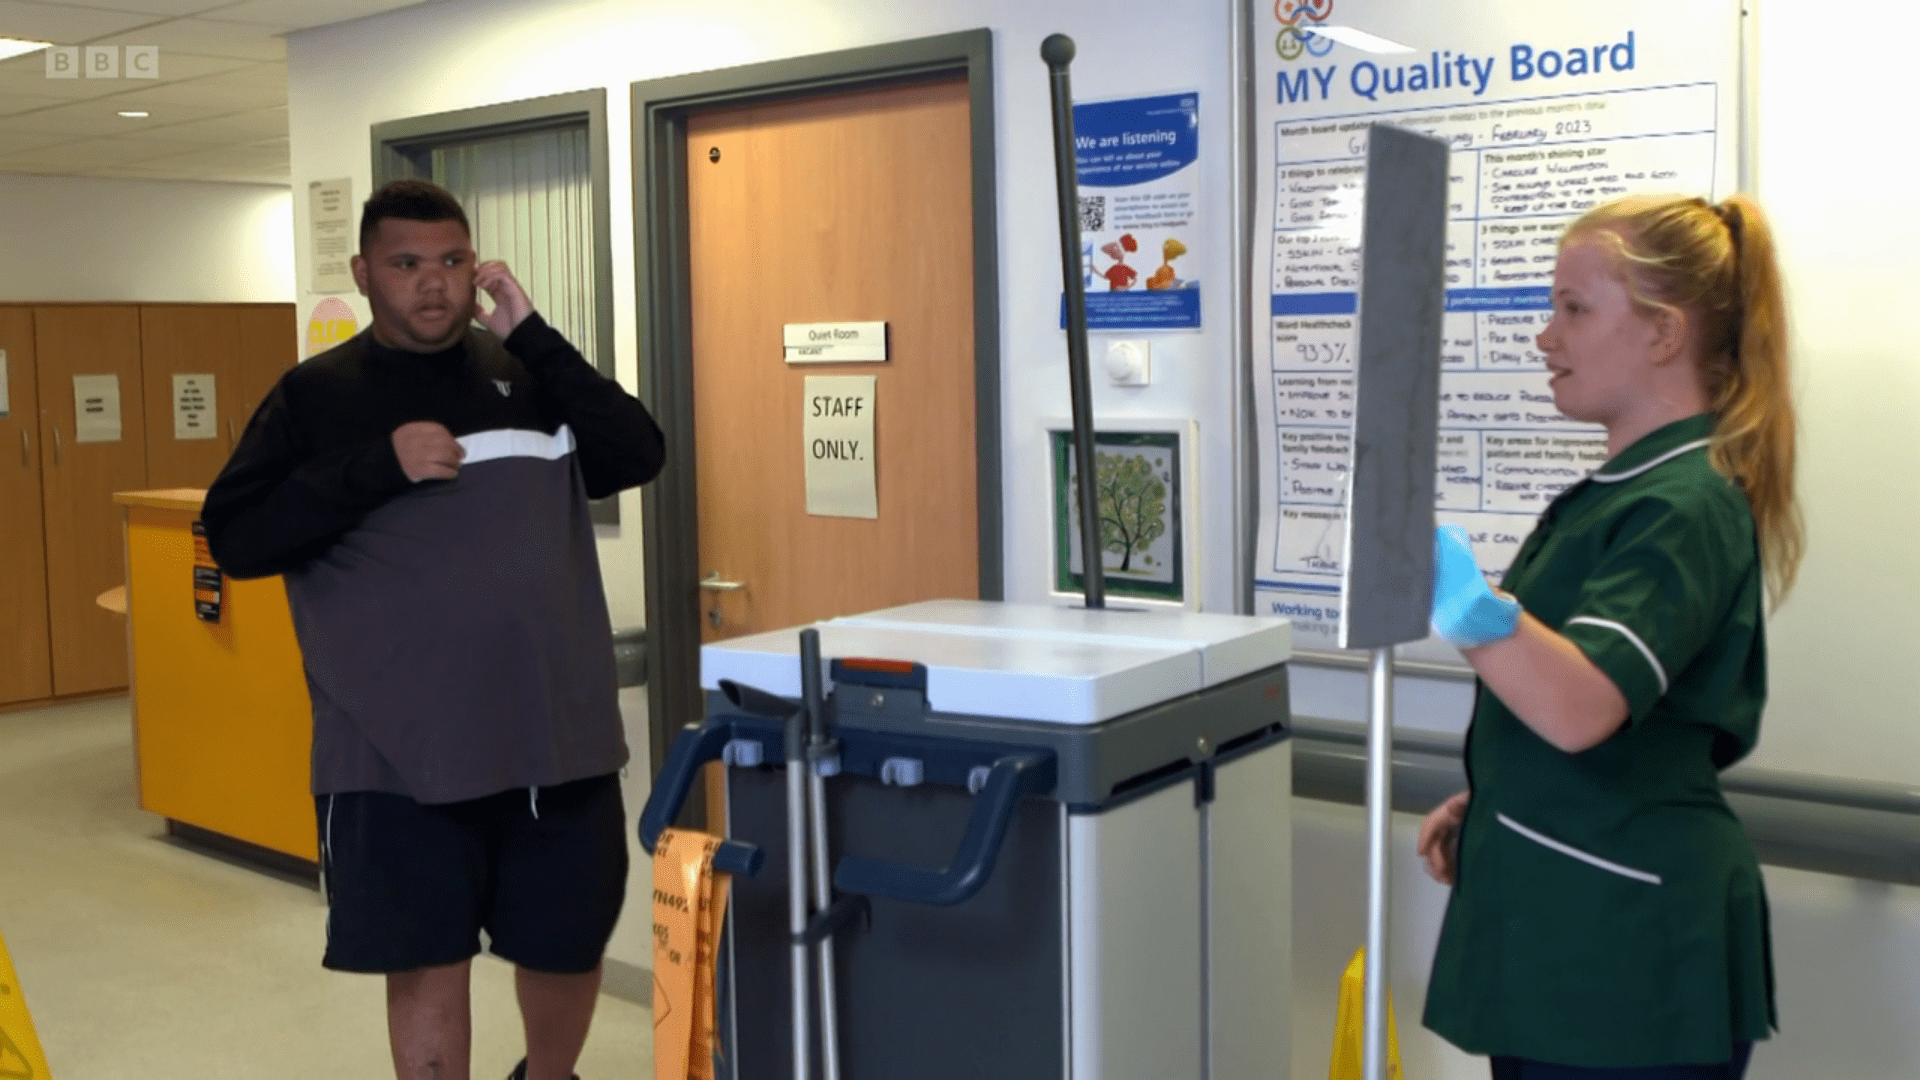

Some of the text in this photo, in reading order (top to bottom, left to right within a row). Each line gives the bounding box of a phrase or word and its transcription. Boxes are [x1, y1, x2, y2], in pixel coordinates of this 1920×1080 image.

[1276, 30, 1635, 105] MY Quality Board
[1280, 126, 1309, 136] Month
[1311, 123, 1337, 134] board
[1555, 119, 1592, 136] 2023
[1076, 129, 1177, 149] We are listening
[1484, 147, 1607, 164] This month's shining star
[1489, 225, 1520, 235] things
[1276, 320, 1351, 329] Ward Healthcheck
[808, 329, 860, 342] Quiet Room
[1278, 377, 1316, 387] Learning
[1317, 377, 1338, 386] from
[812, 395, 864, 418] STAFF
[1282, 432, 1298, 442] Key
[1300, 433, 1333, 442] positive
[1486, 436, 1504, 446] Key
[1507, 437, 1533, 445] areas
[1535, 436, 1550, 445] for
[812, 438, 864, 461] ONLY.
[1282, 443, 1309, 454] family
[1486, 450, 1521, 460] patient
[1523, 450, 1542, 459] and
[1544, 450, 1575, 461] family
[1283, 509, 1299, 520] Key
[1271, 601, 1323, 620] Working
